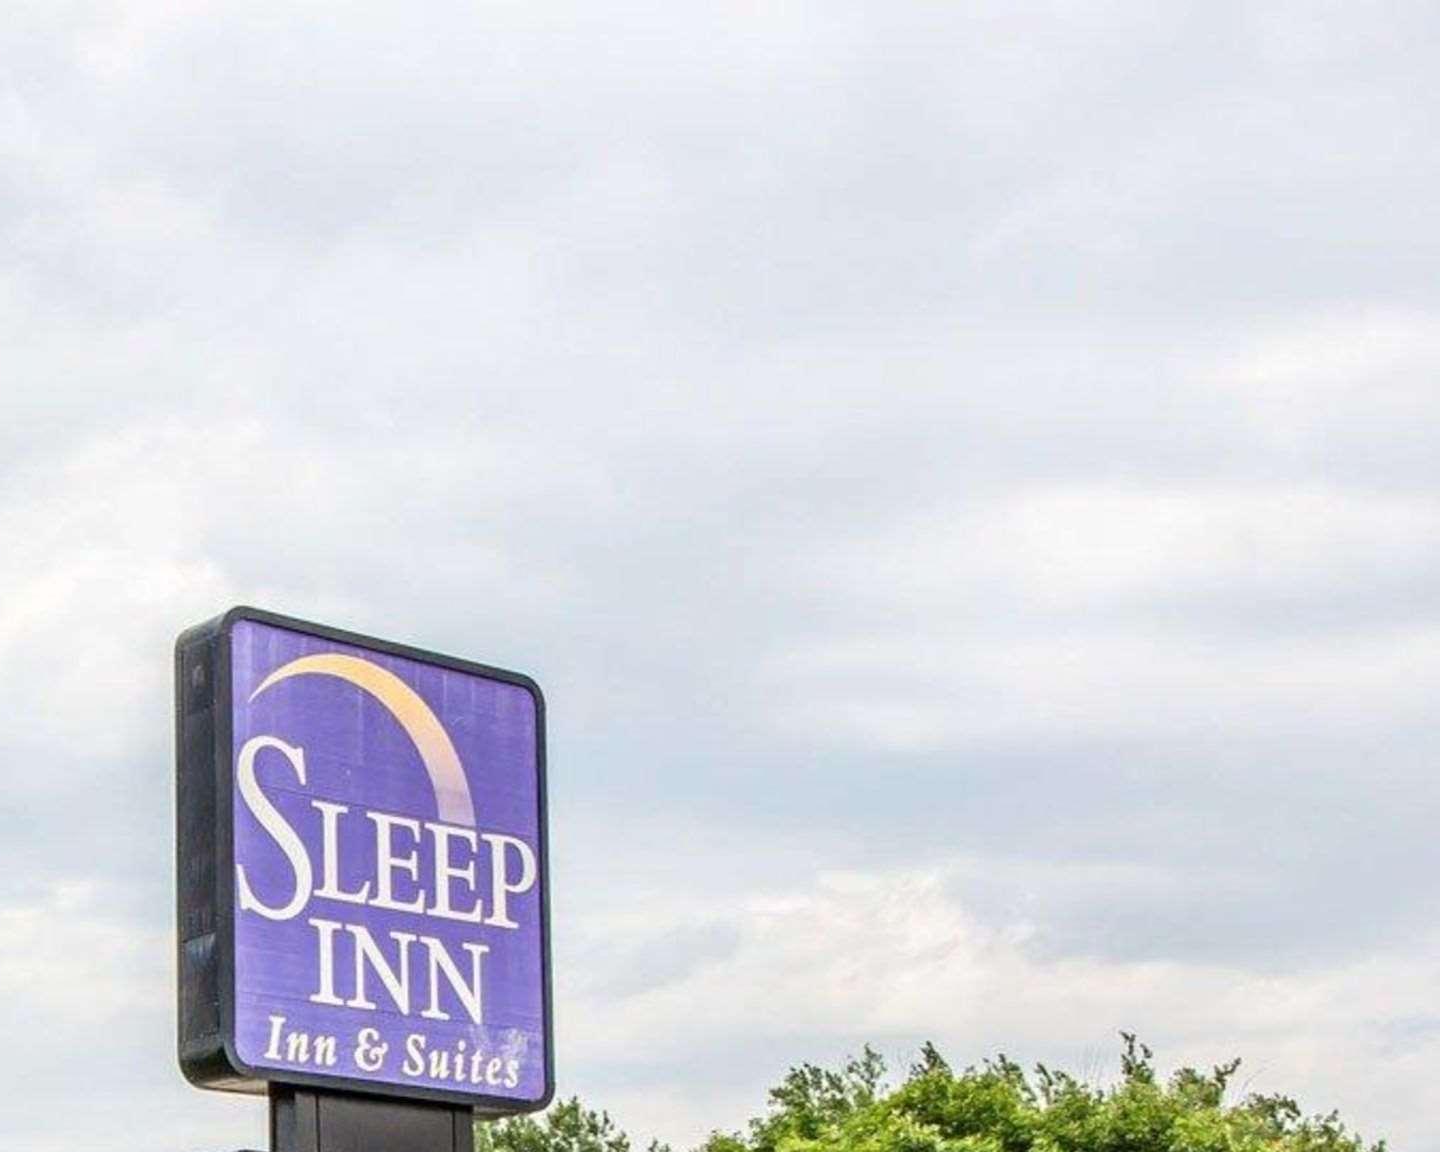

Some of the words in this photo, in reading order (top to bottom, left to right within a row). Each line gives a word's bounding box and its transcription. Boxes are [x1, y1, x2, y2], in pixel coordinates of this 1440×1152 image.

[237, 736, 537, 928] SLEEP
[309, 918, 489, 1025] INN
[264, 1015, 338, 1066] Inn
[353, 1027, 388, 1072] &
[402, 1033, 520, 1088] Suites
